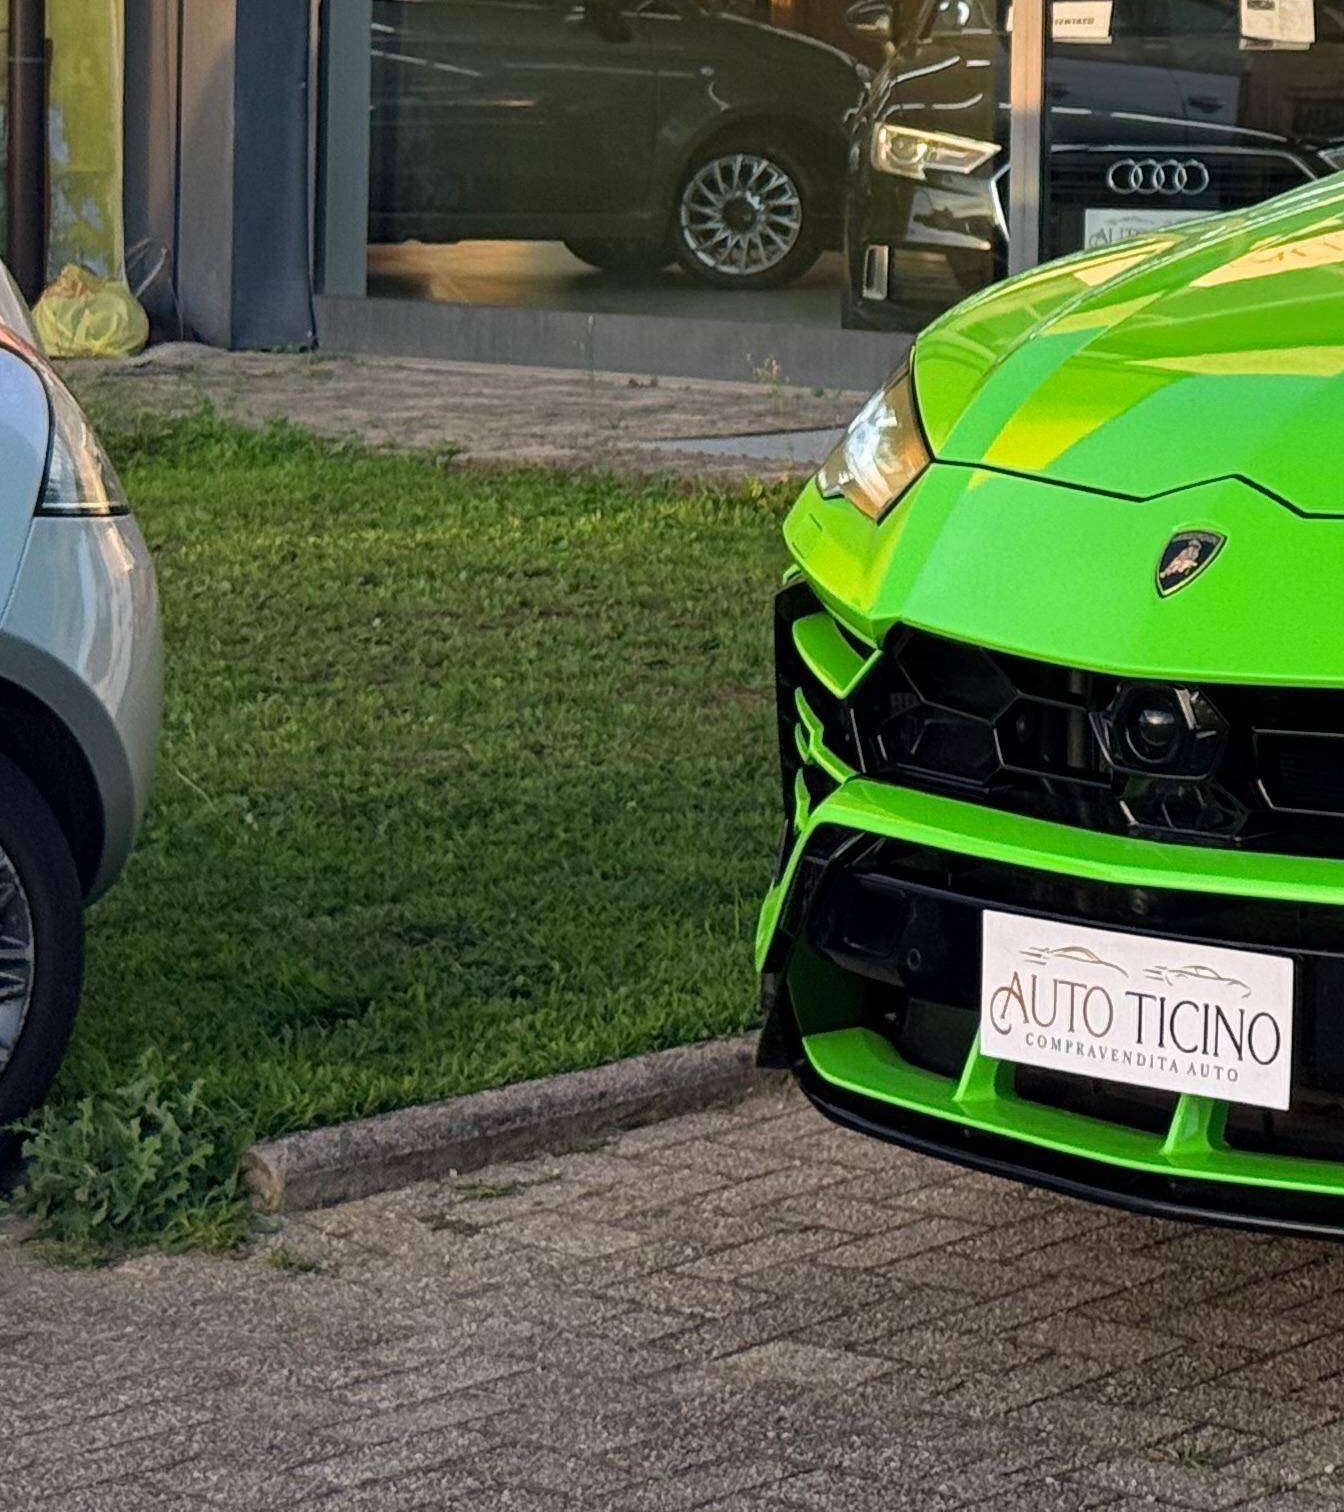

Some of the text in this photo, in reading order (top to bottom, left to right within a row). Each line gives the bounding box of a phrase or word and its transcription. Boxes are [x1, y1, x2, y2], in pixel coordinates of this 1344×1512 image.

[989, 970, 1281, 1066] AUTO TICINO
[1025, 1032, 1239, 1083] COMPRAVENDITA AUTO
